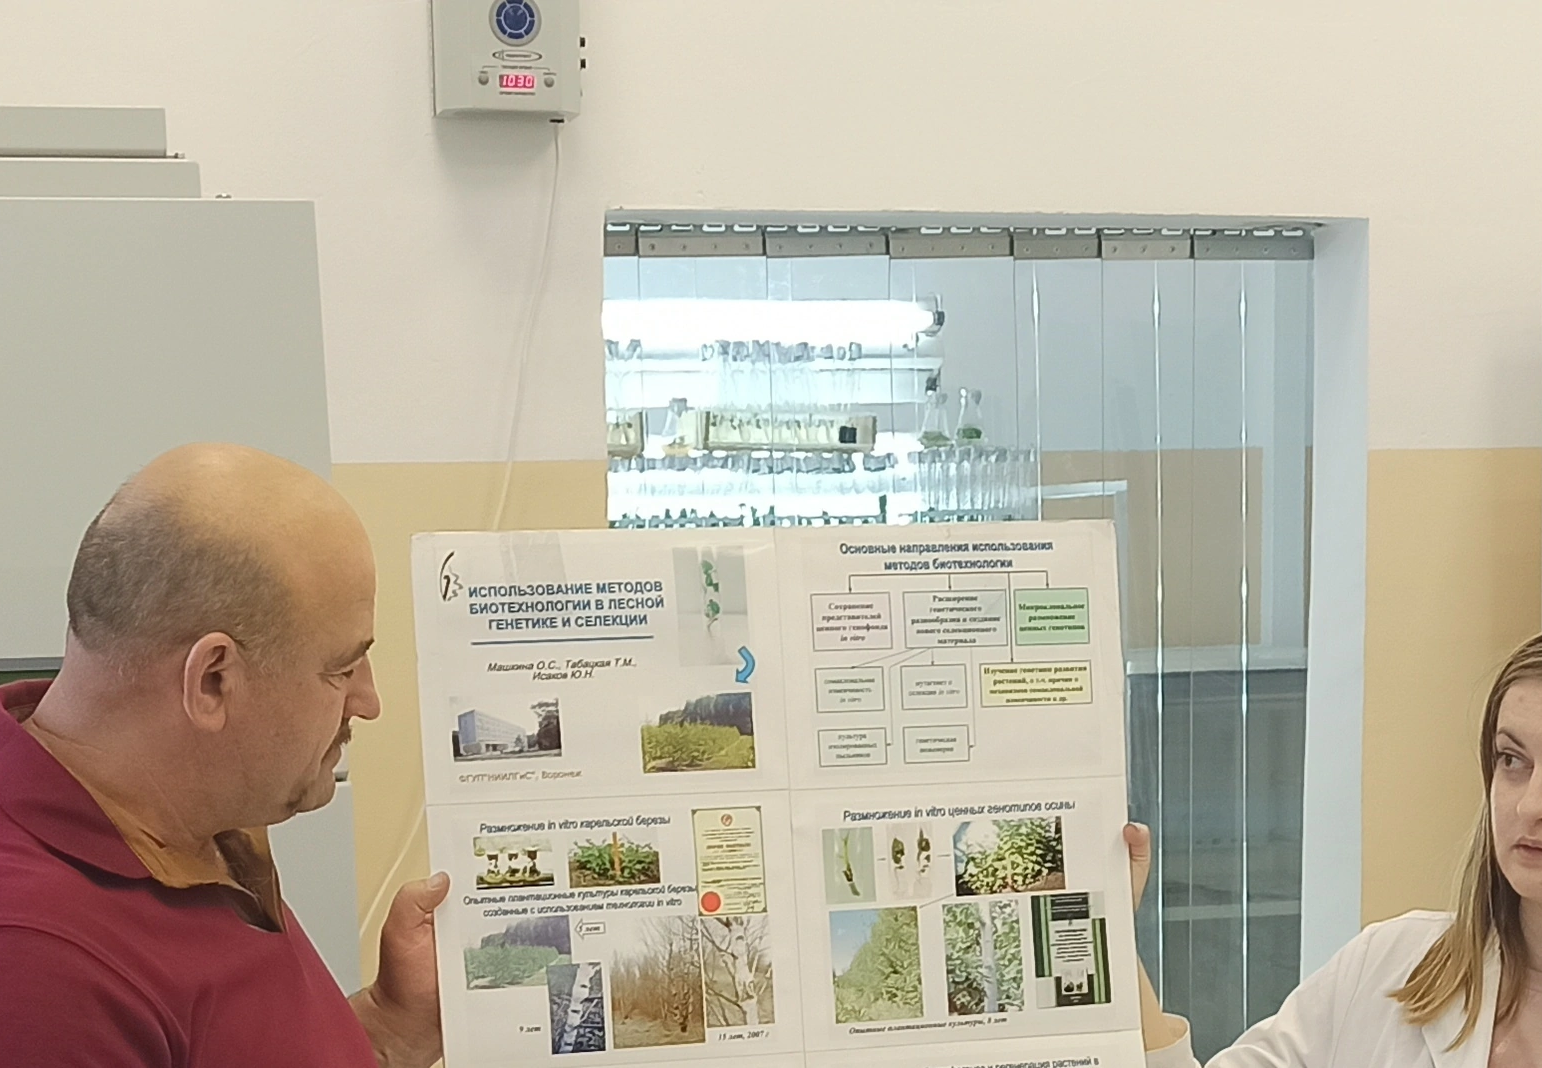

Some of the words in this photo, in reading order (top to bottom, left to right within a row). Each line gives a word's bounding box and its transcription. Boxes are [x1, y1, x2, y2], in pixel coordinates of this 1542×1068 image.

[840, 543, 897, 554] Основные
[899, 543, 969, 554] направления
[972, 540, 1053, 552] использования
[885, 560, 930, 570] методов
[932, 558, 1013, 569] биотехнологии
[469, 583, 592, 598] ИСПОЛЬЗОВАНИЕ
[597, 581, 663, 594] МЕТОДОВ
[470, 599, 591, 614] БИОТЕХНОЛОГИИ
[595, 599, 603, 610] В
[608, 595, 664, 610] ЛЕСНОЙ
[489, 616, 558, 630] ГЕНЕТИКЕ
[563, 617, 570, 627] И
[575, 615, 647, 628] СЕЛЕКЦИИ
[533, 672, 568, 681] Исаков
[844, 809, 911, 822] Размножение
[914, 807, 922, 818] in
[925, 806, 945, 817] vitro
[948, 806, 984, 817] ценных
[987, 803, 1042, 814] генотипов
[1044, 801, 1075, 811] осины
[480, 823, 545, 834] Размножение
[548, 820, 556, 829] in
[559, 820, 578, 829] vitro
[580, 817, 633, 829] карельской
[636, 816, 670, 827] березы
[1052, 1056, 1091, 1068] растений
